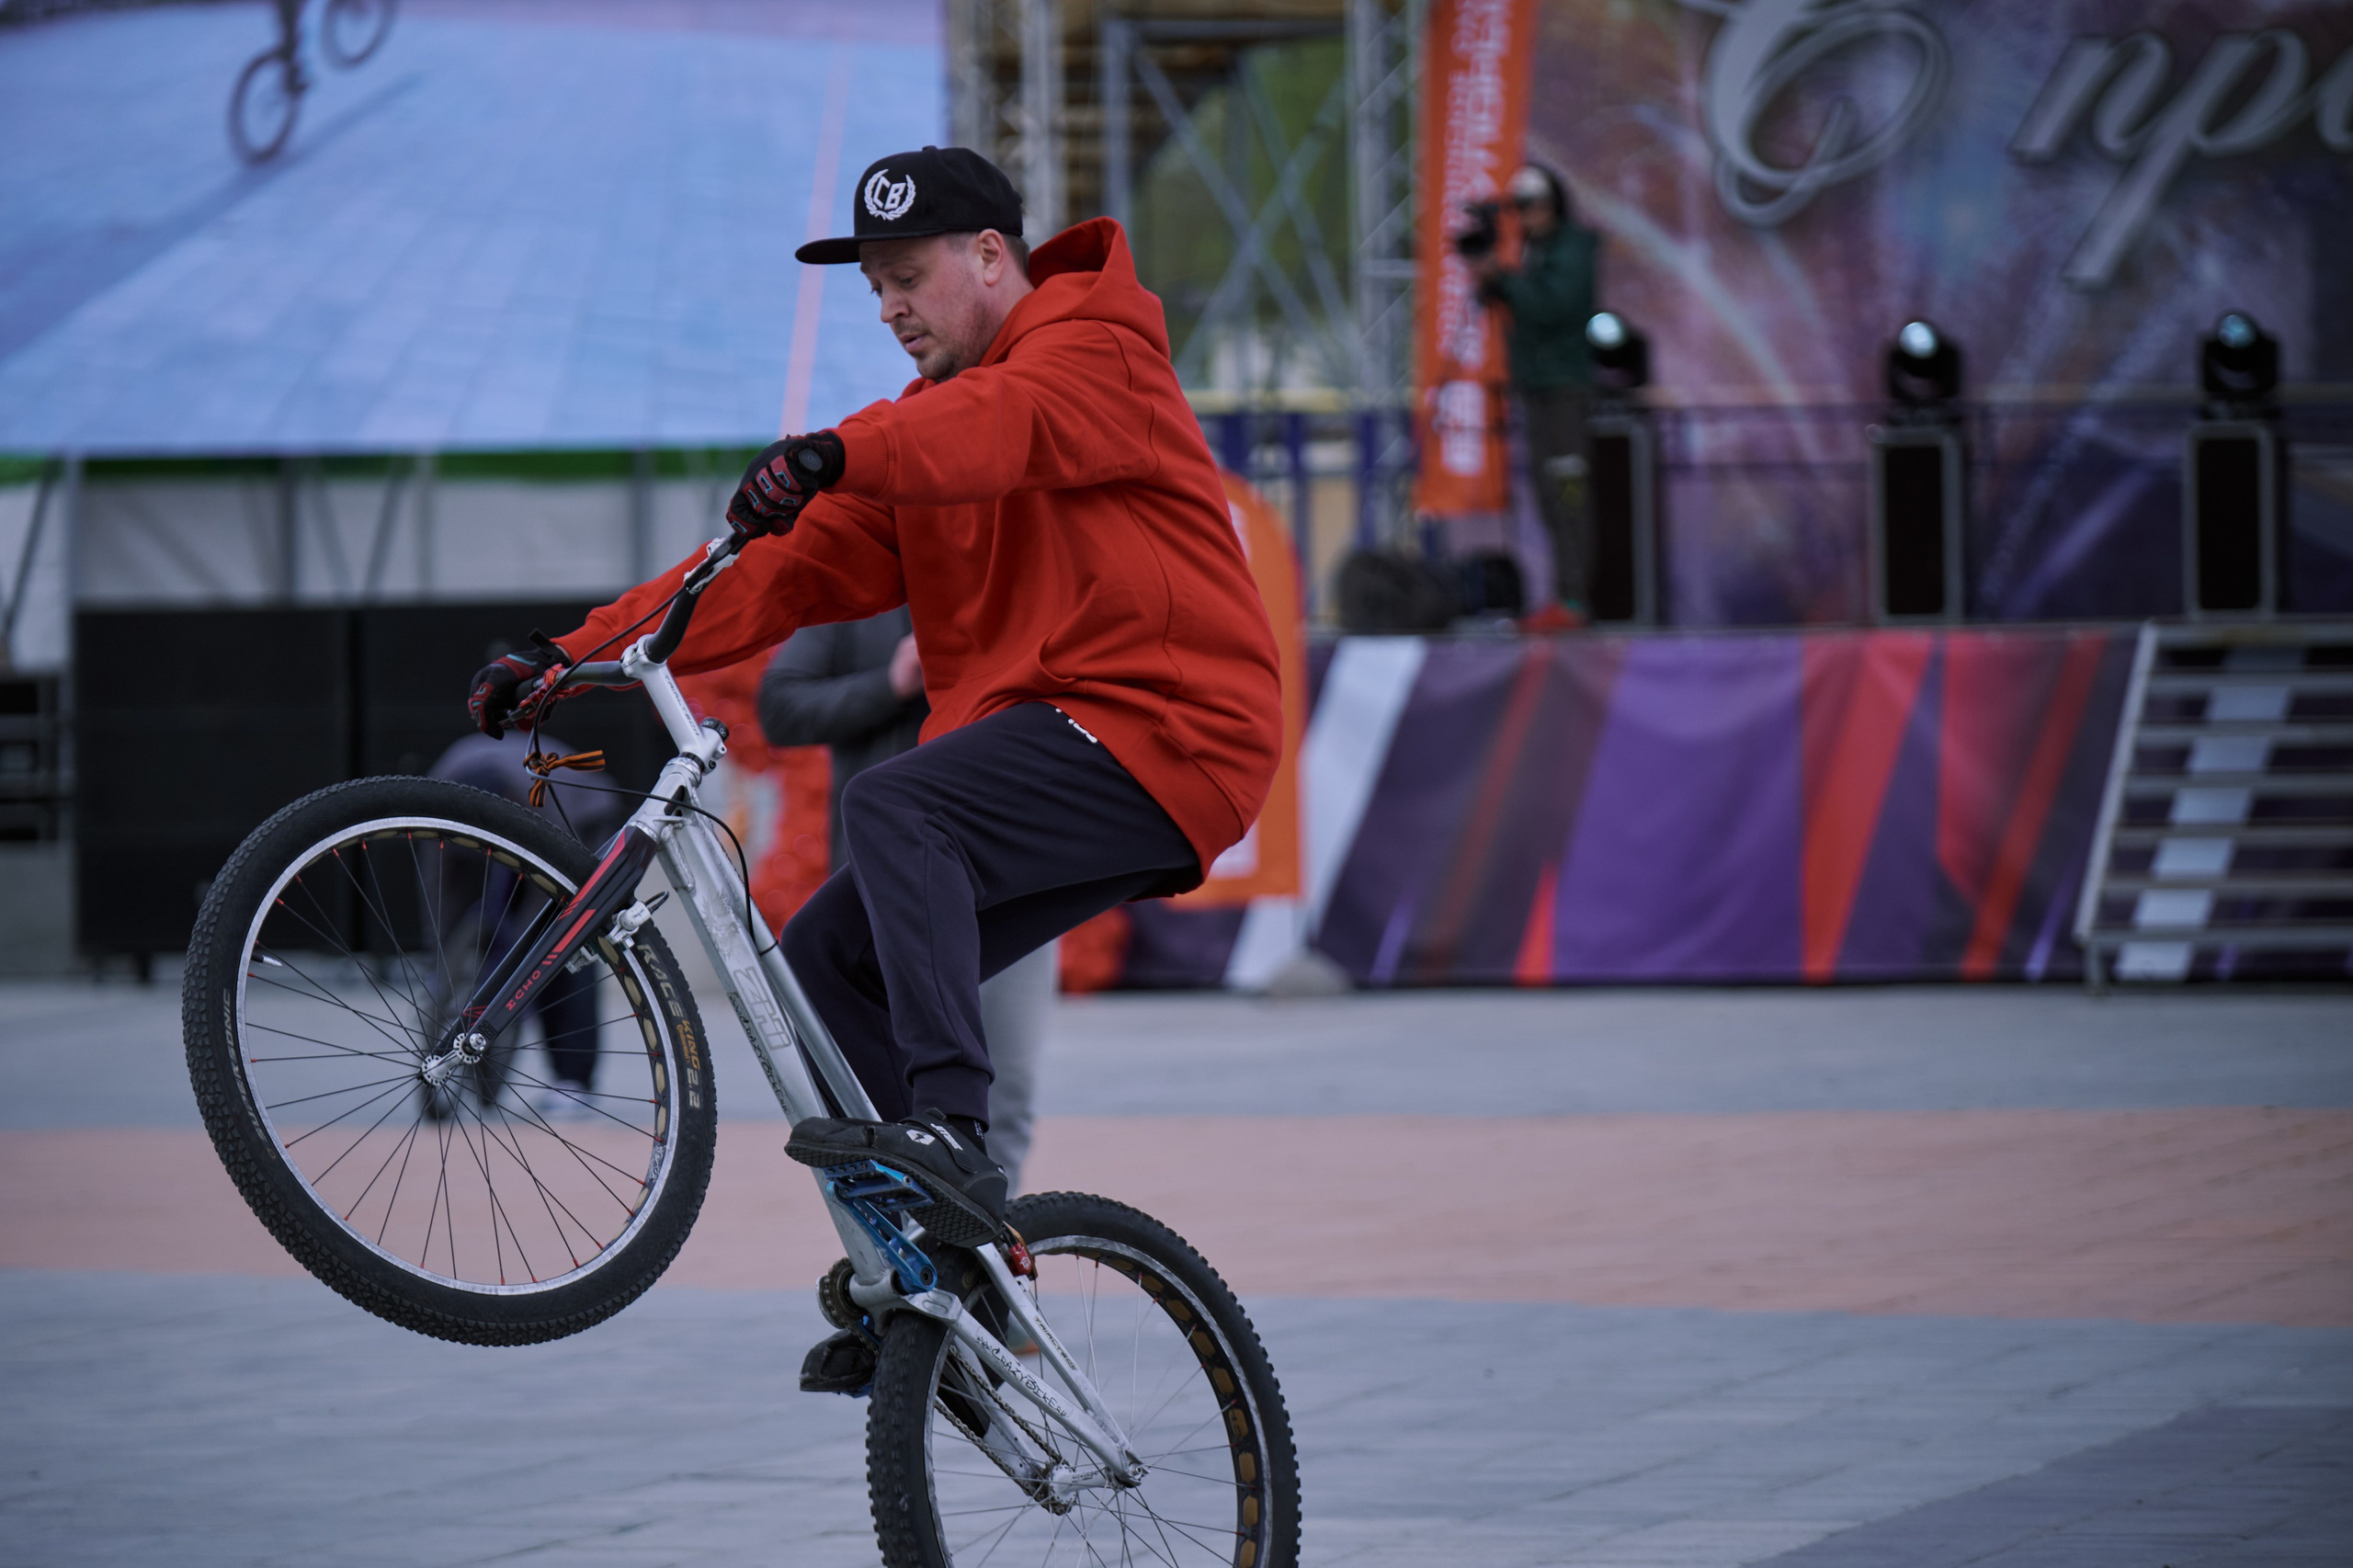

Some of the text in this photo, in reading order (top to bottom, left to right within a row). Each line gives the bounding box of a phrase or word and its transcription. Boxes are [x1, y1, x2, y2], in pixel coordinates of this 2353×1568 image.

[872, 176, 906, 210] CB
[506, 970, 541, 1011] ECHO
[637, 943, 700, 1109] RACE KING 2.2
[676, 1024, 690, 1063] Continental
[222, 988, 267, 1143] SUPERSONIC
